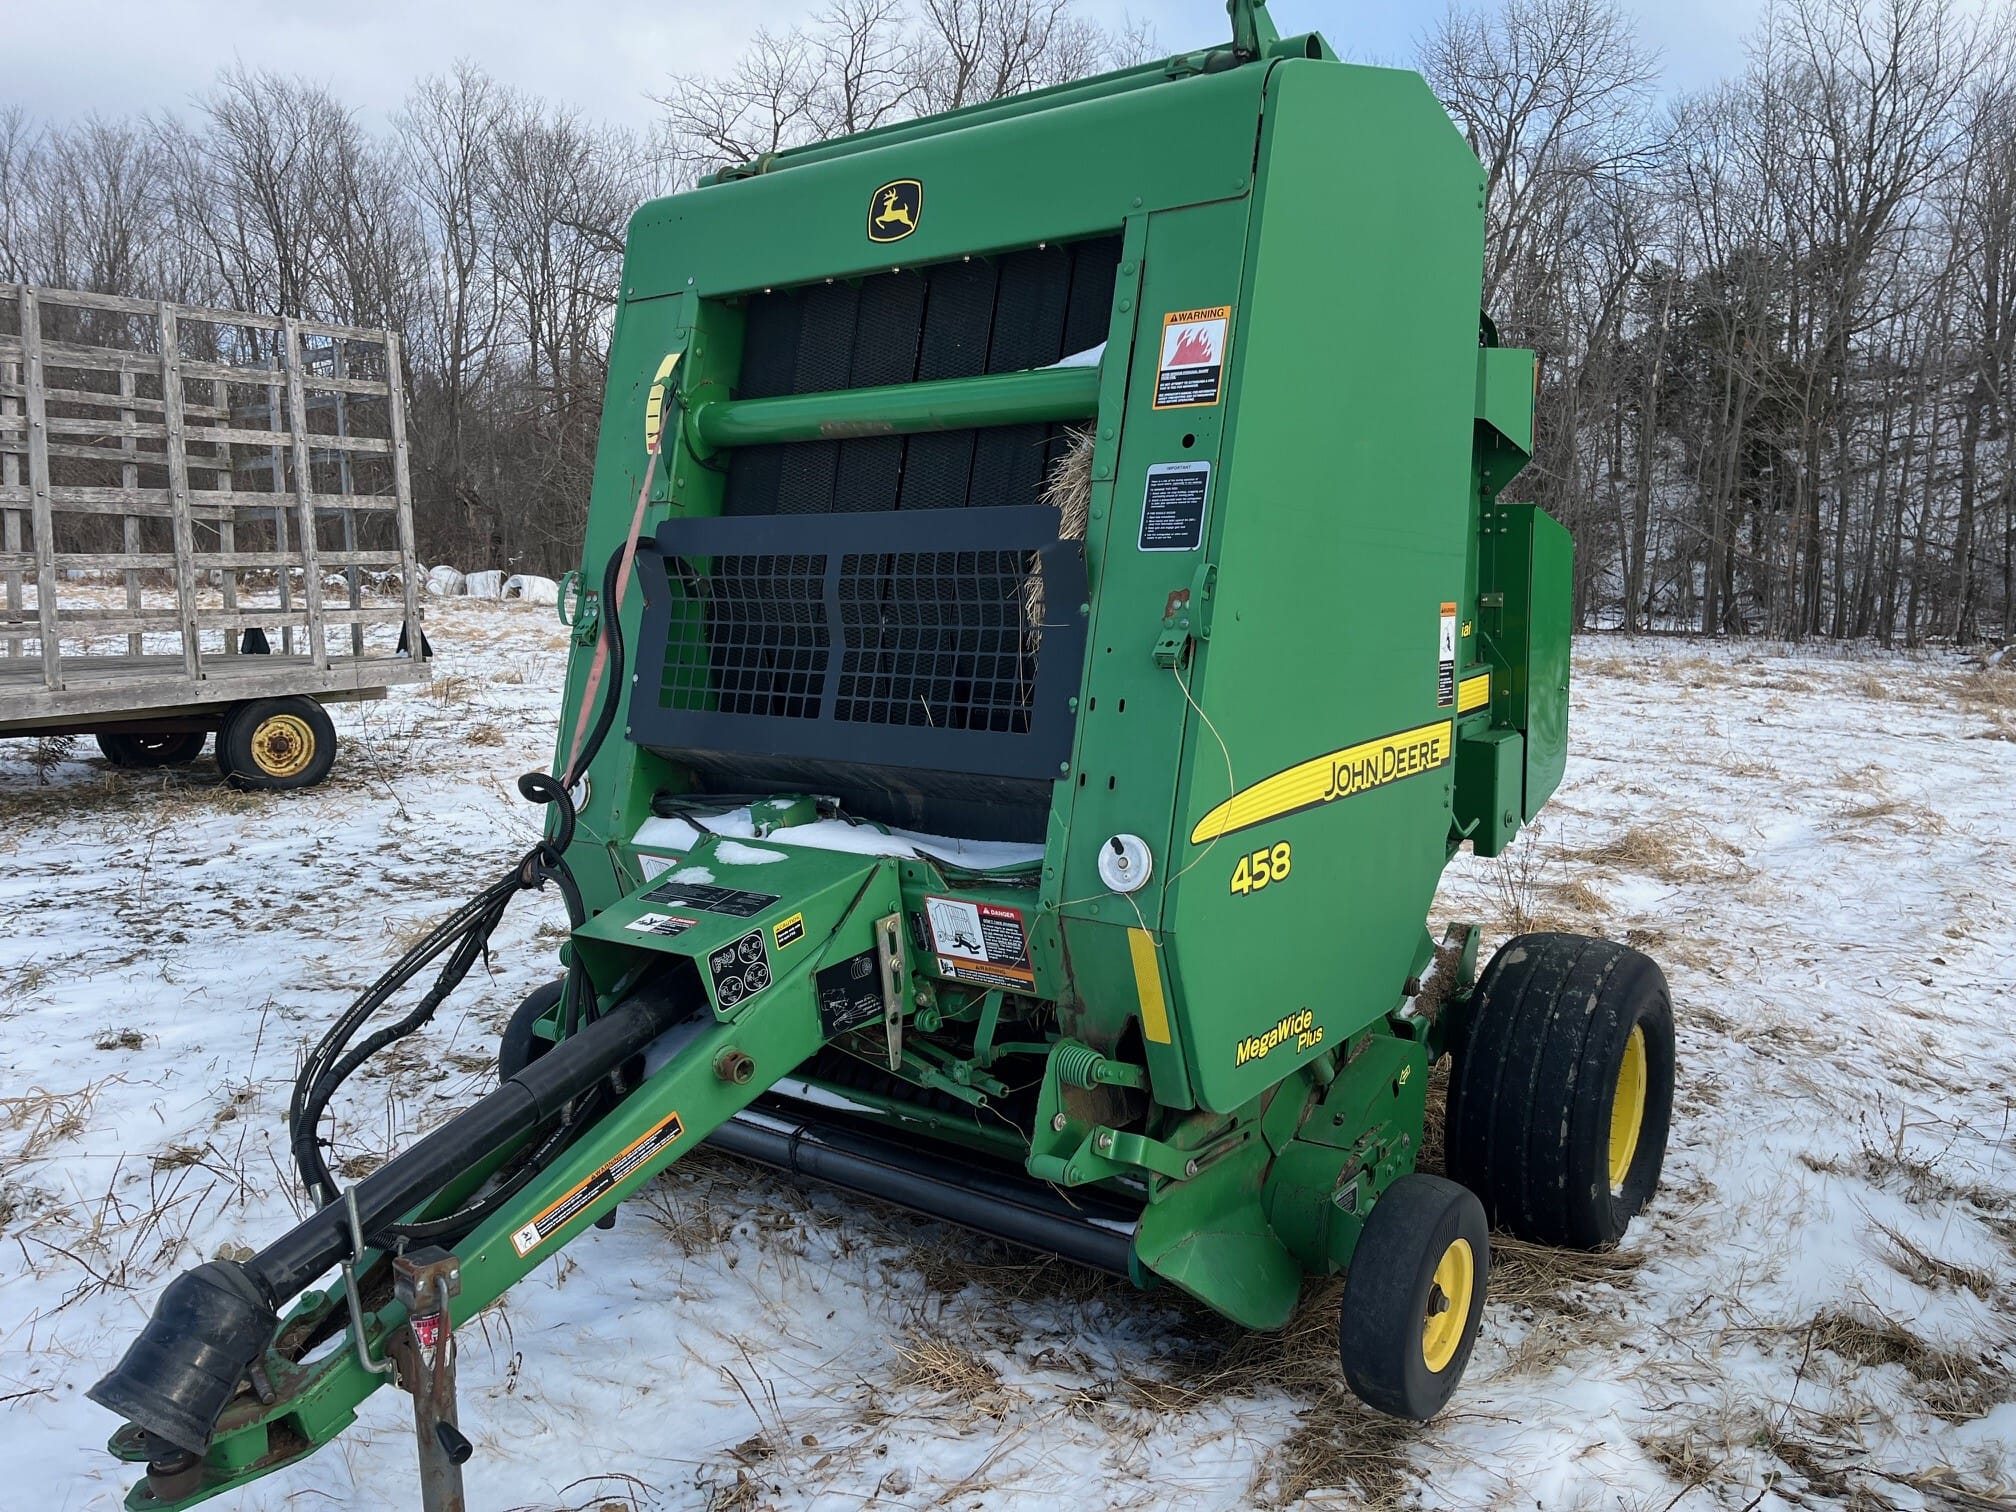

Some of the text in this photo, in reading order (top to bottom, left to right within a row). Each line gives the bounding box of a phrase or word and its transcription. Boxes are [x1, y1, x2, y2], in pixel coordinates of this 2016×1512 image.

[1178, 307, 1224, 321] WARNING
[1324, 738, 1440, 797] JOHN DEERE
[1230, 840, 1291, 896] 458
[991, 909, 1015, 919] DANGER
[980, 965, 1006, 975] WARNING
[1235, 1007, 1313, 1068] MegaWide
[1296, 1026, 1323, 1054] Plus
[594, 1153, 623, 1176] WARNING
